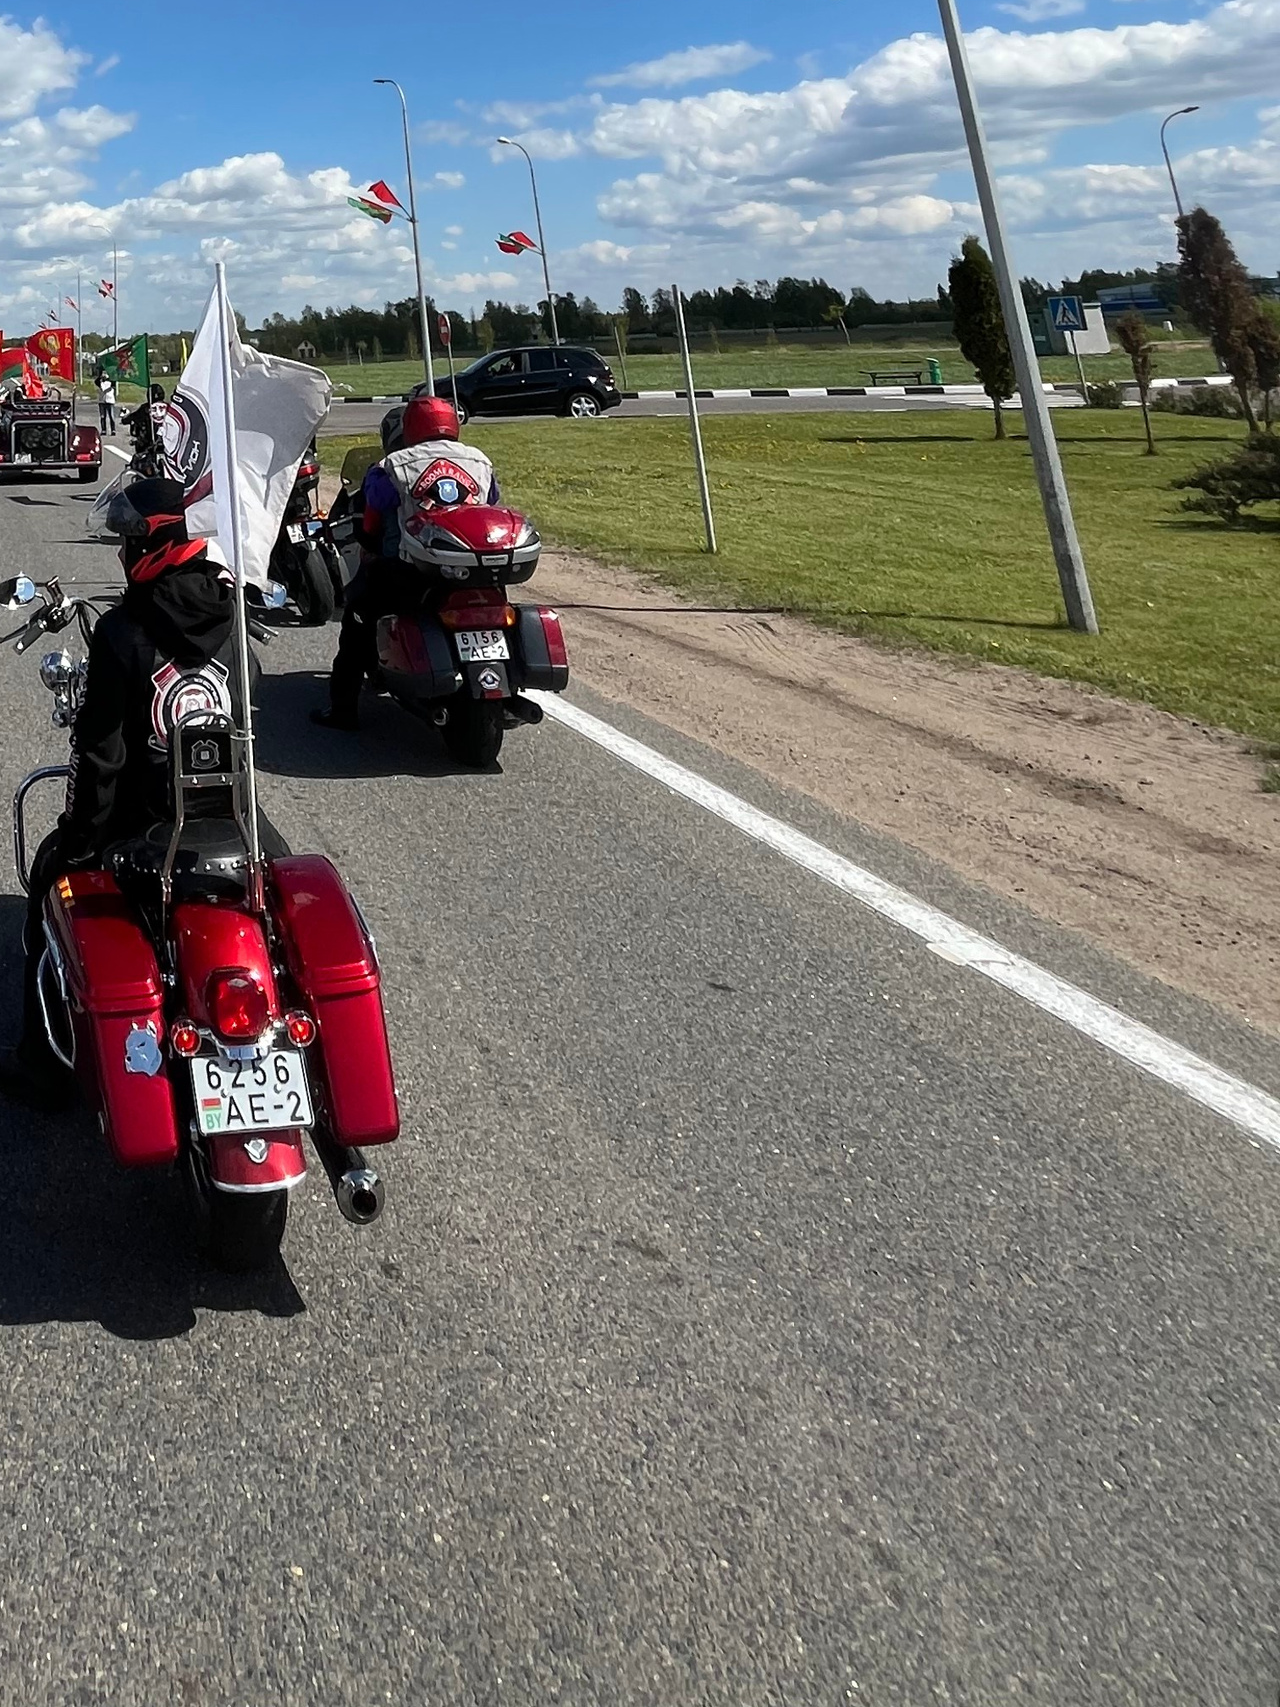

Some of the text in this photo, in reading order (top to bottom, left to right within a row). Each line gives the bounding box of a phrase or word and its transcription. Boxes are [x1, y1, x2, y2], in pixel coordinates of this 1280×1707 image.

[419, 467, 472, 490] BOOMERANG
[460, 631, 499, 646] 6156
[471, 645, 506, 659] AE-2
[205, 1051, 290, 1089] 6256
[206, 1090, 305, 1130] BY AE-2
